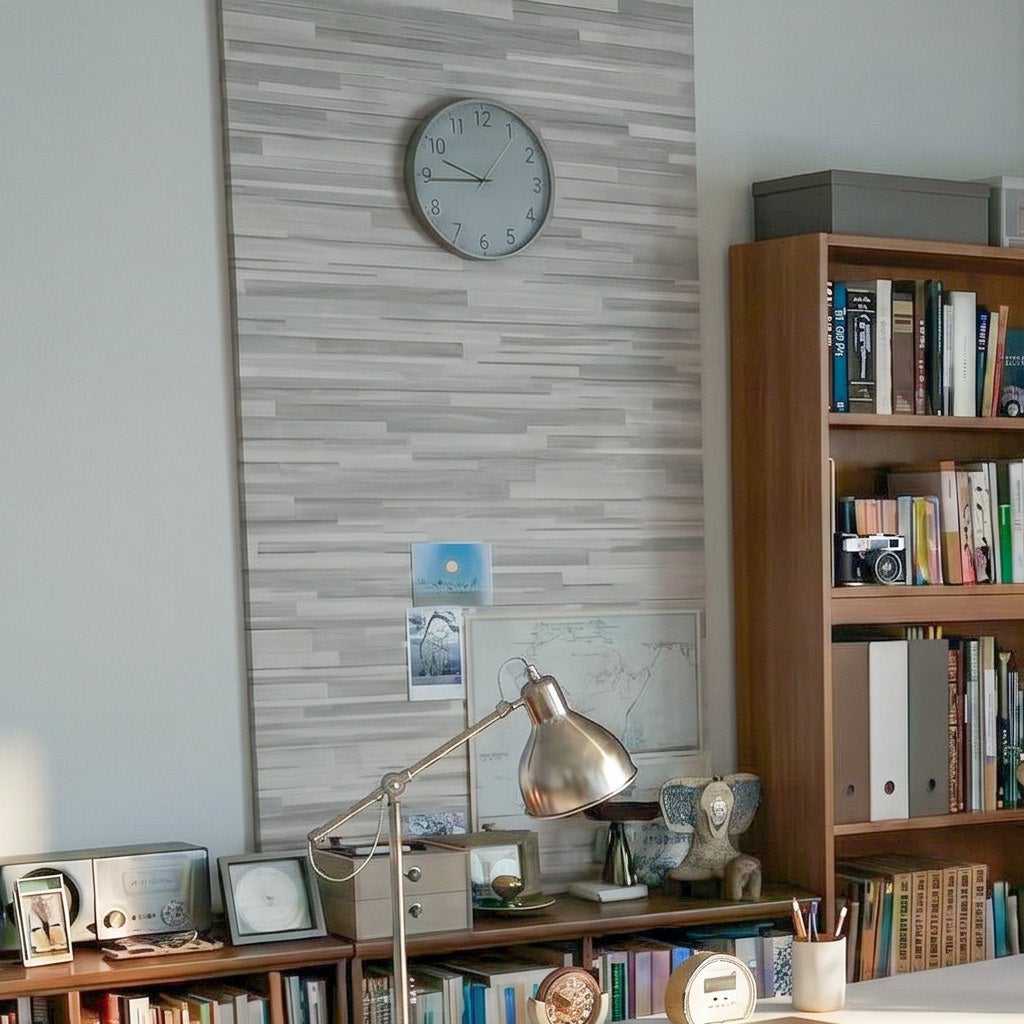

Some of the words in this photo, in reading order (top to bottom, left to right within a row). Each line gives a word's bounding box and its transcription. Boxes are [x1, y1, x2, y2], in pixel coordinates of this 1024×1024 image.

[450, 118, 463, 135] 11
[475, 111, 491, 127] 12
[506, 124, 513, 139] 1
[429, 138, 445, 154] 10
[525, 148, 535, 163] 2
[422, 167, 432, 183] 9
[533, 178, 541, 193] 3
[431, 199, 440, 215] 8
[526, 207, 536, 223] 4
[453, 223, 462, 244] 7
[480, 234, 489, 249] 6
[506, 229, 515, 245] 5
